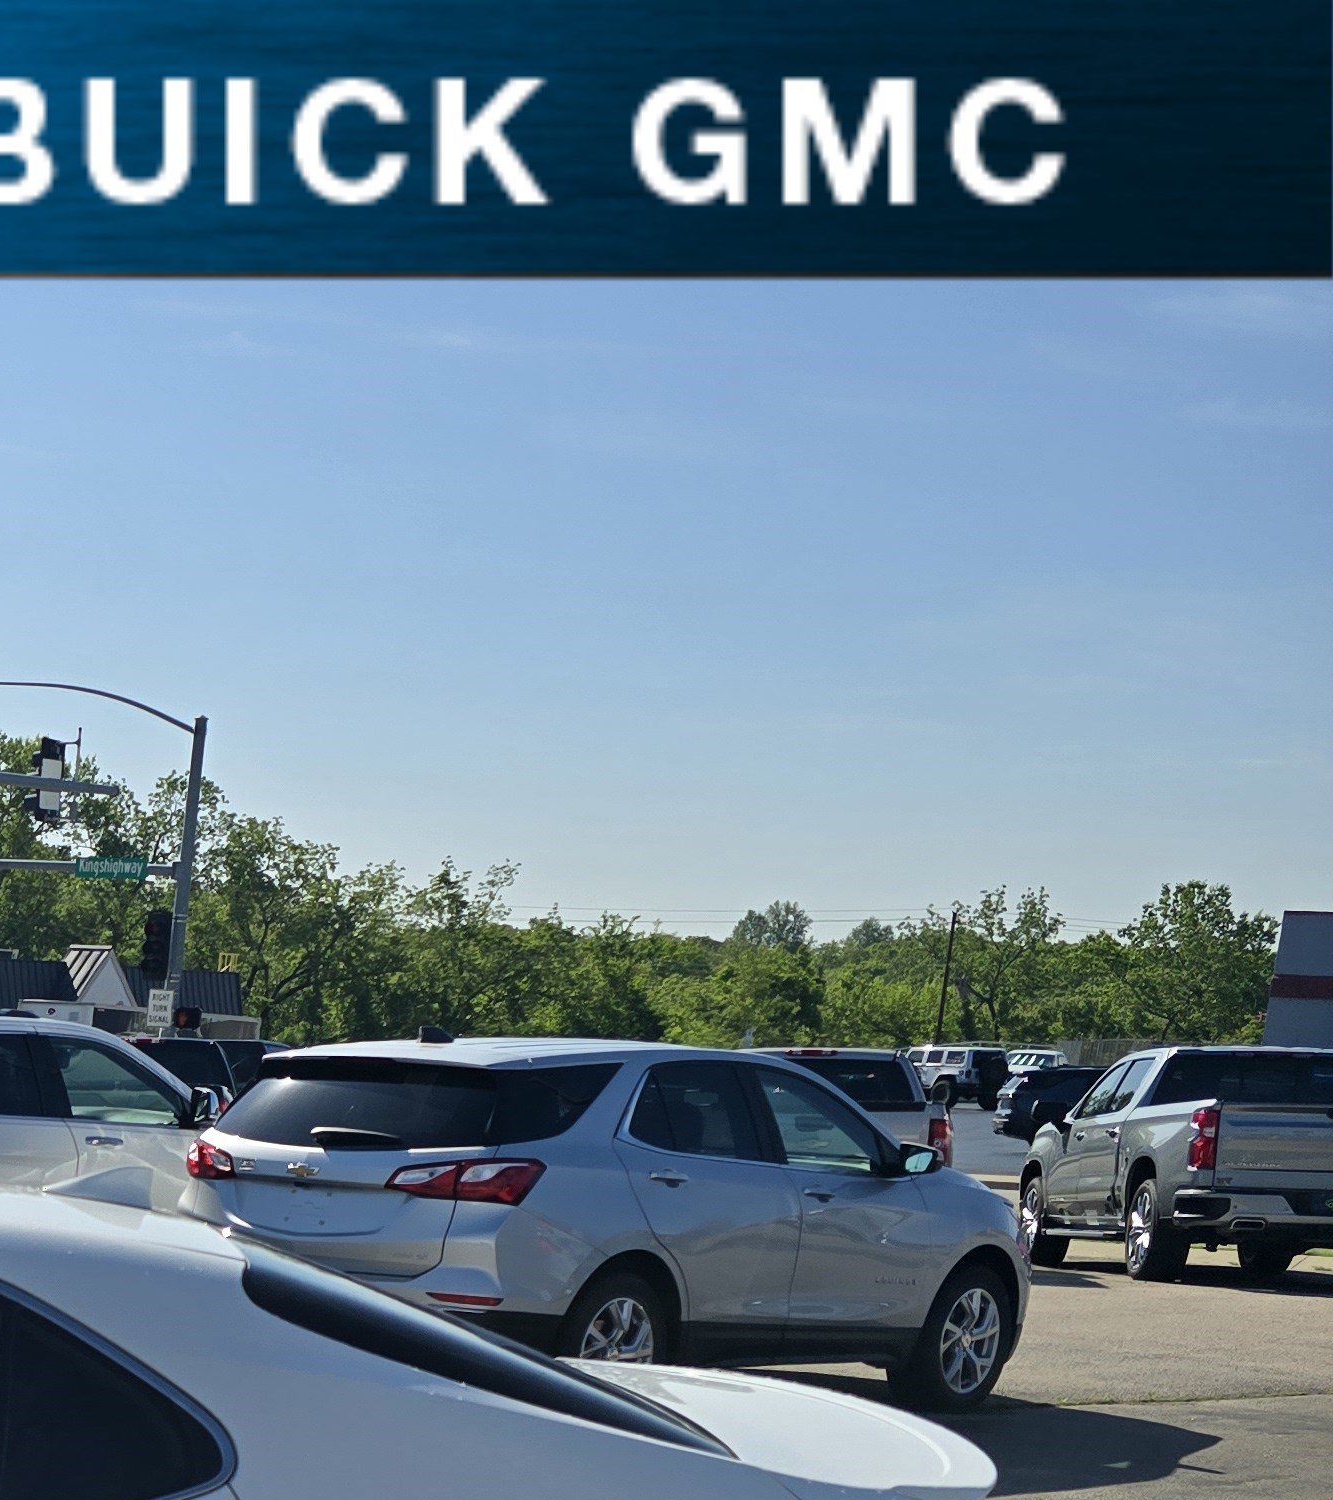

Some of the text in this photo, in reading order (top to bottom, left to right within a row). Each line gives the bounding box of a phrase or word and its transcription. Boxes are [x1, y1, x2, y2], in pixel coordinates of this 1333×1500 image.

[78, 858, 144, 878] Kingshighway
[152, 993, 170, 1001] RIGHT
[152, 1003, 168, 1012] TURN
[148, 1014, 169, 1024] SIGNAL
